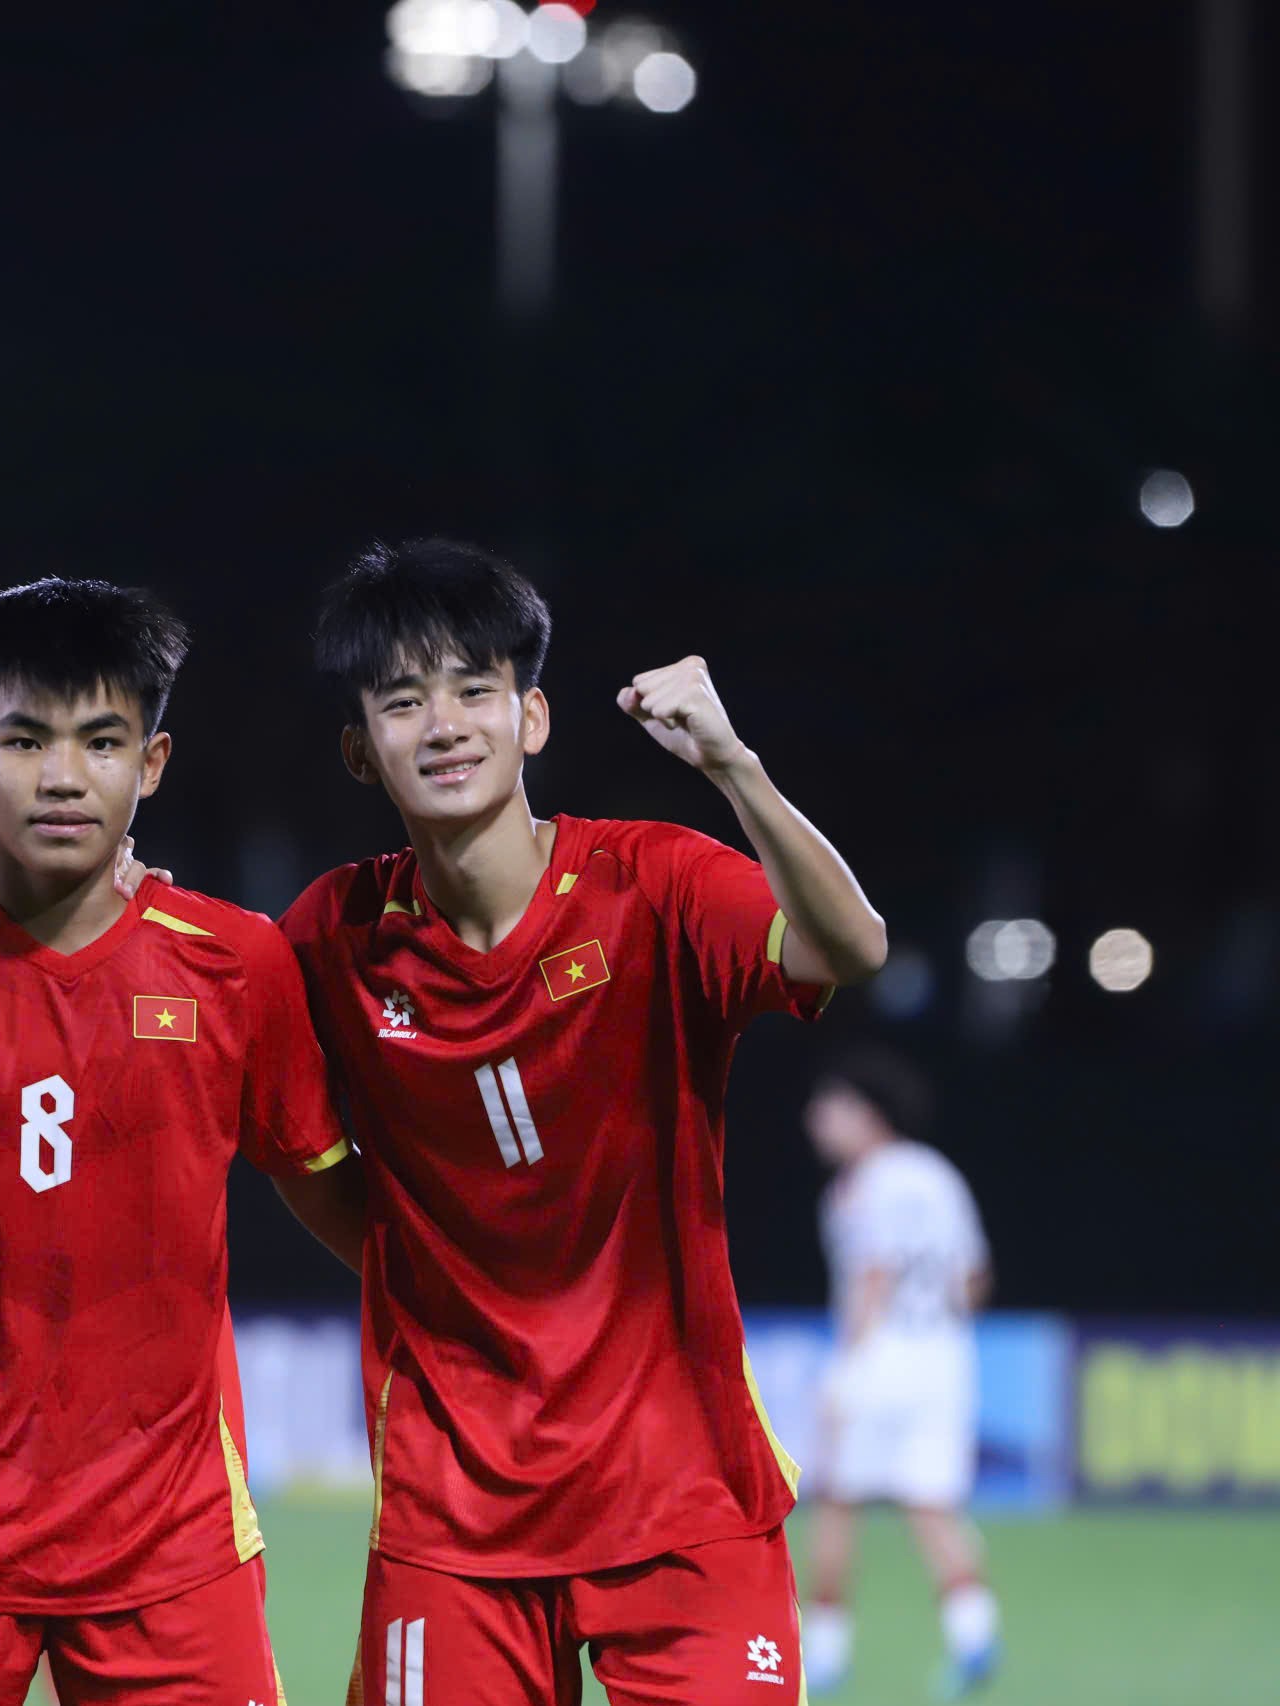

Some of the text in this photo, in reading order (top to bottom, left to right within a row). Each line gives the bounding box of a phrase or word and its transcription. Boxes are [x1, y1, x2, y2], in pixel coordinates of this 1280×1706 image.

[20, 1075, 74, 1193] 8
[474, 1057, 545, 1168] 11
[386, 1618, 426, 1706] 11
